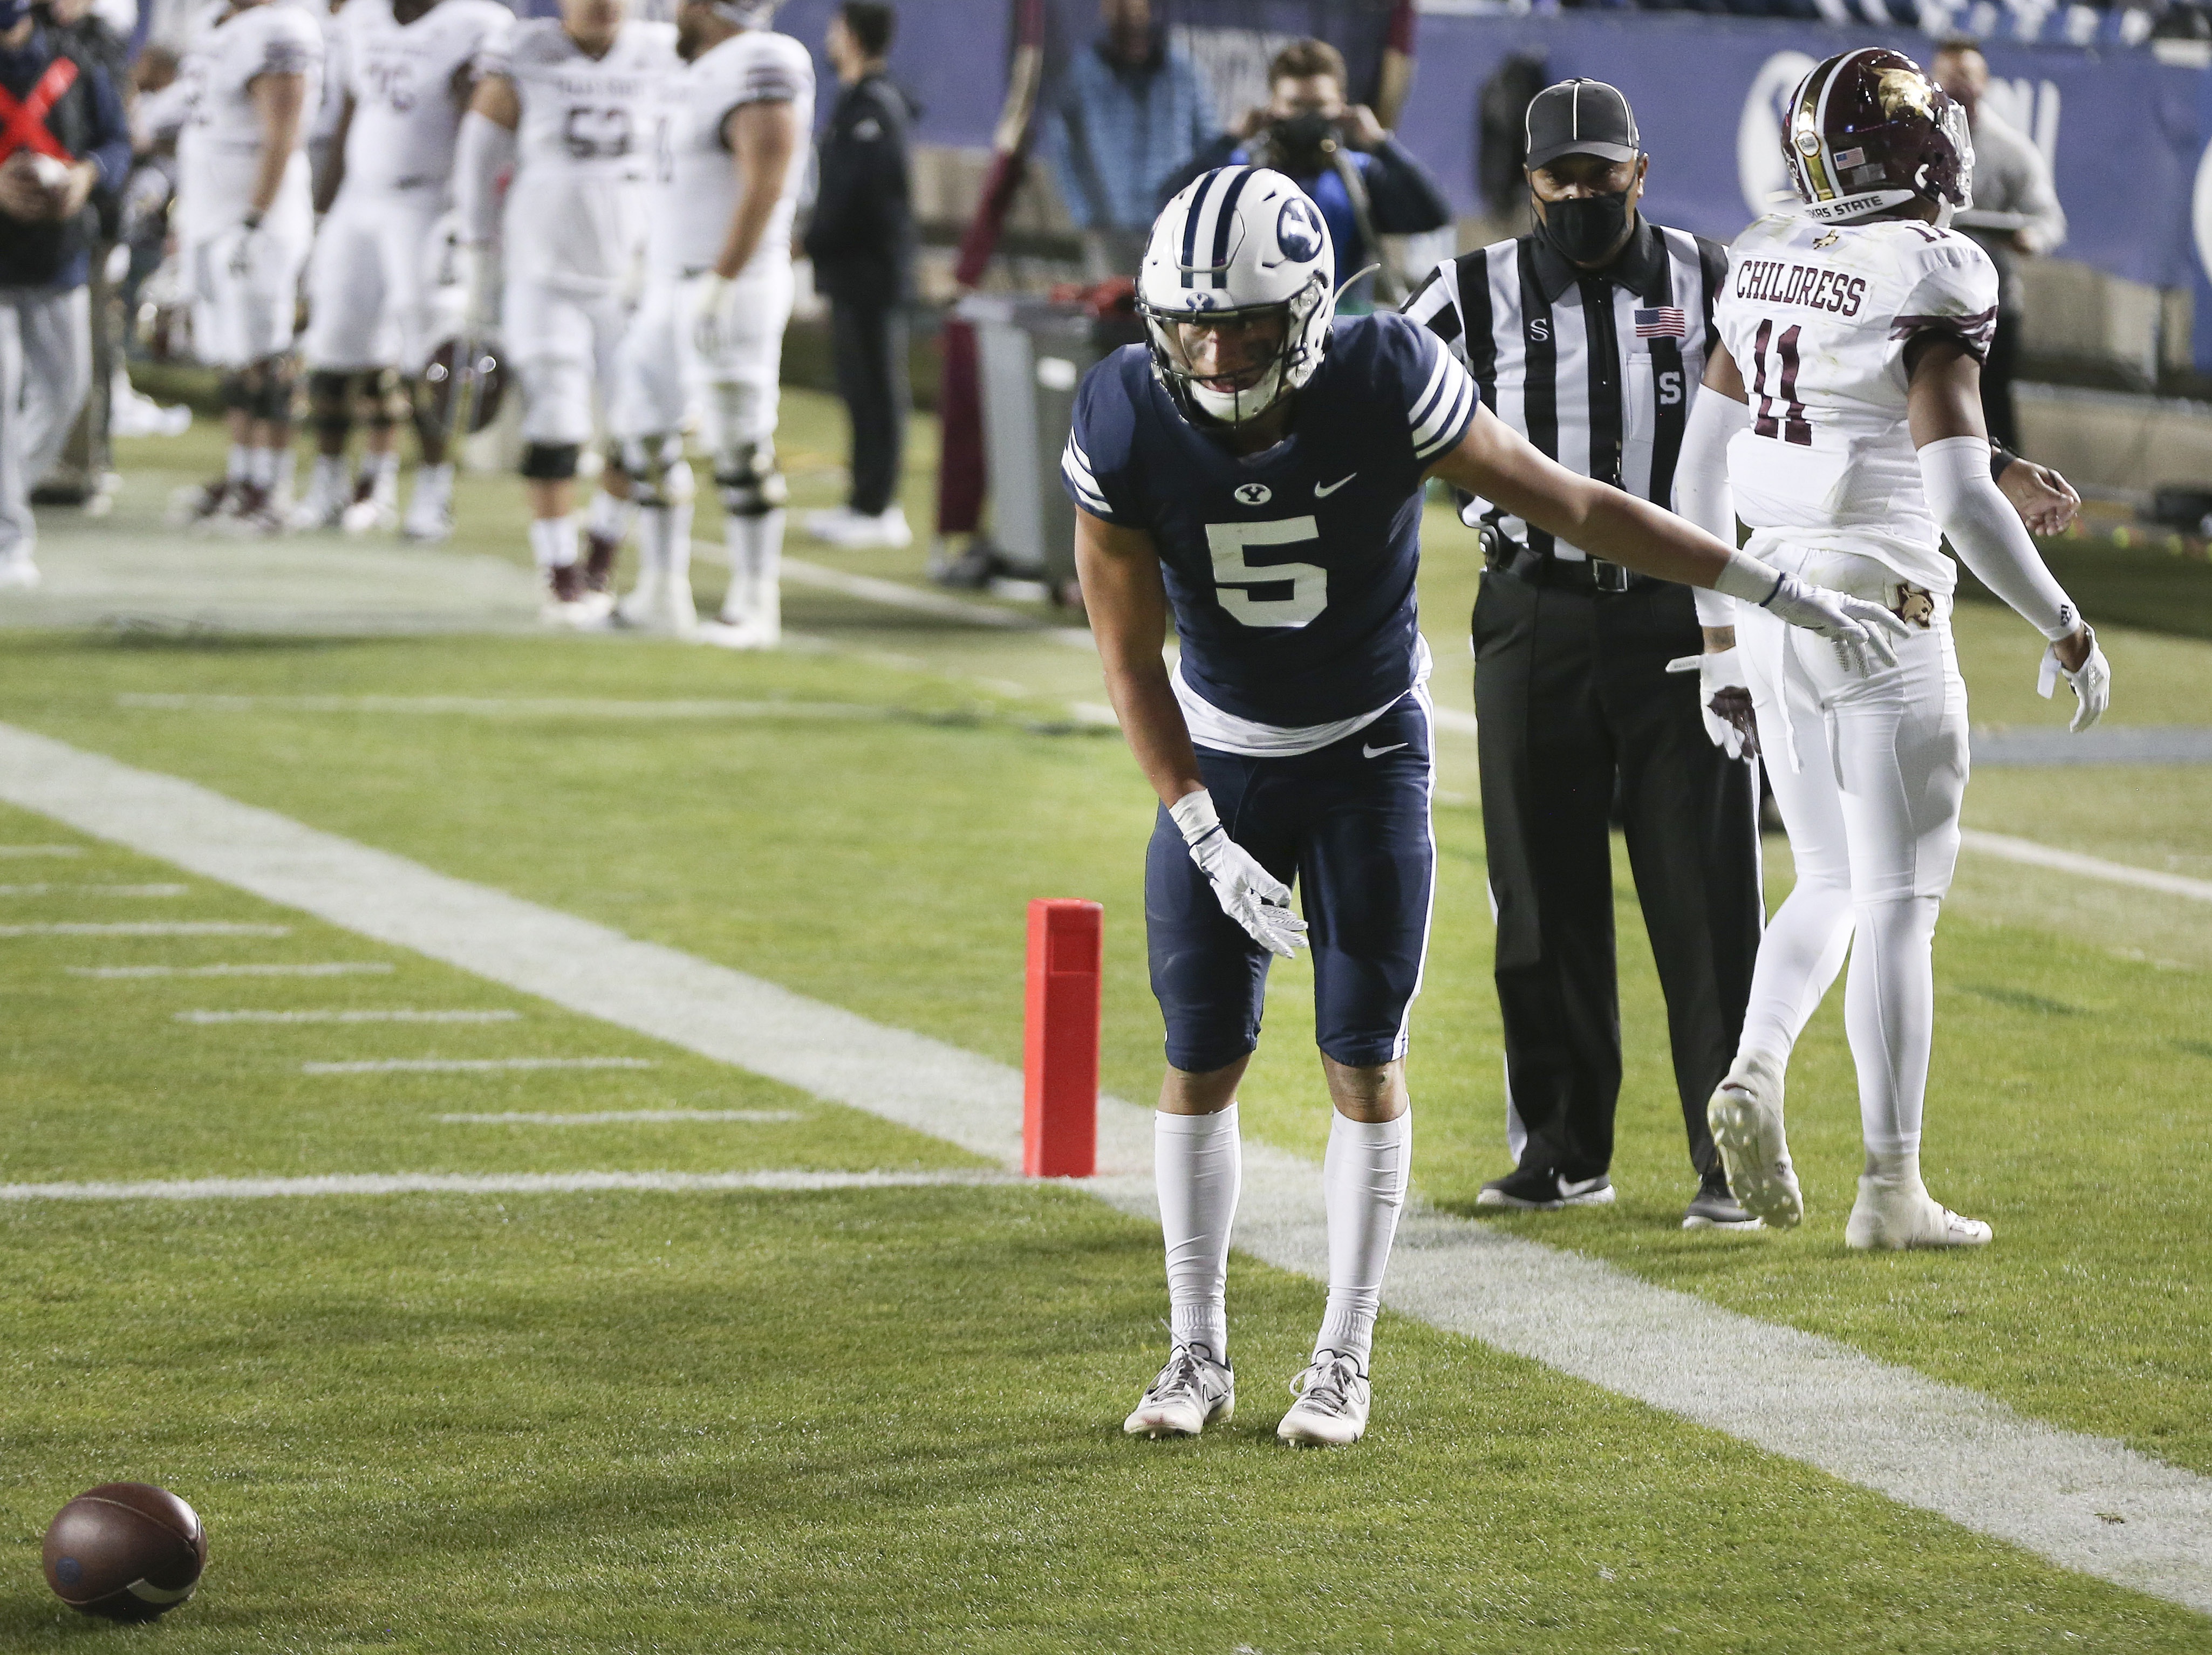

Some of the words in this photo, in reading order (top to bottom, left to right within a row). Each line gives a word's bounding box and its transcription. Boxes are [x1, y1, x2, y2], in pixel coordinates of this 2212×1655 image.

[1834, 195, 1883, 215] STATE
[1737, 261, 1866, 317] CHILDRESS
[1530, 317, 1549, 341] S
[1659, 371, 1682, 405] S
[1753, 318, 1812, 447] 11
[1241, 485, 1266, 502] Y
[1205, 514, 1328, 627] 5
